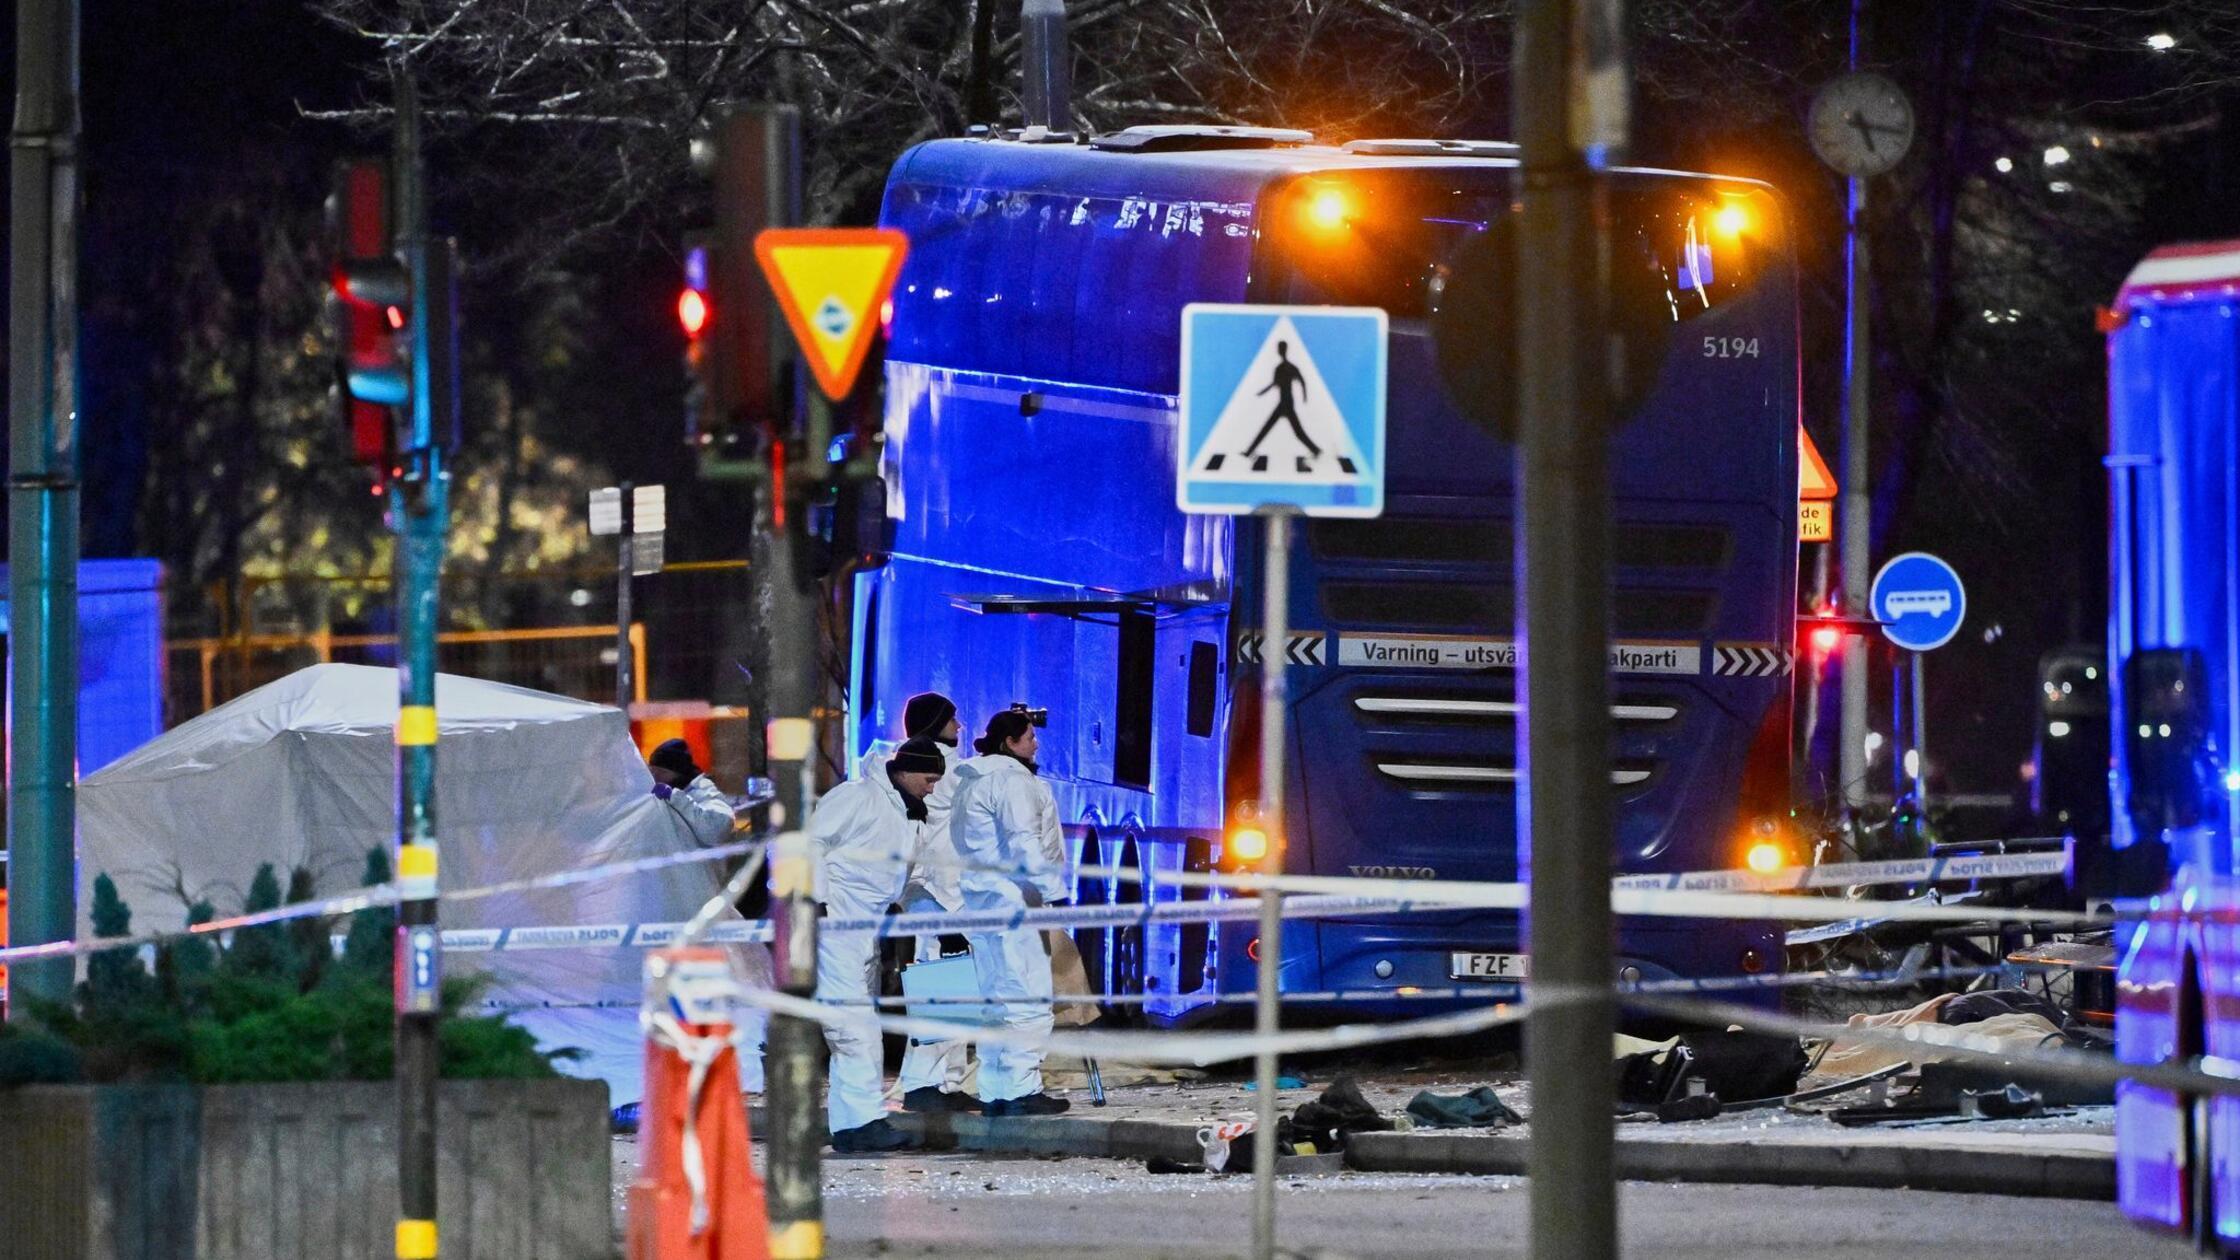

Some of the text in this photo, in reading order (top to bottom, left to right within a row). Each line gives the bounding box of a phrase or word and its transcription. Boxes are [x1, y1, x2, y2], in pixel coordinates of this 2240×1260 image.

[1703, 336, 1760, 358] 5194
[1801, 505, 1820, 519] de
[1803, 522, 1822, 535] fik
[1363, 642, 1439, 665] Varning
[1465, 645, 1517, 664] utsvä
[1609, 648, 1677, 670] akparti
[1347, 865, 1436, 880] VOLVO
[1470, 955, 1510, 975] FZF
